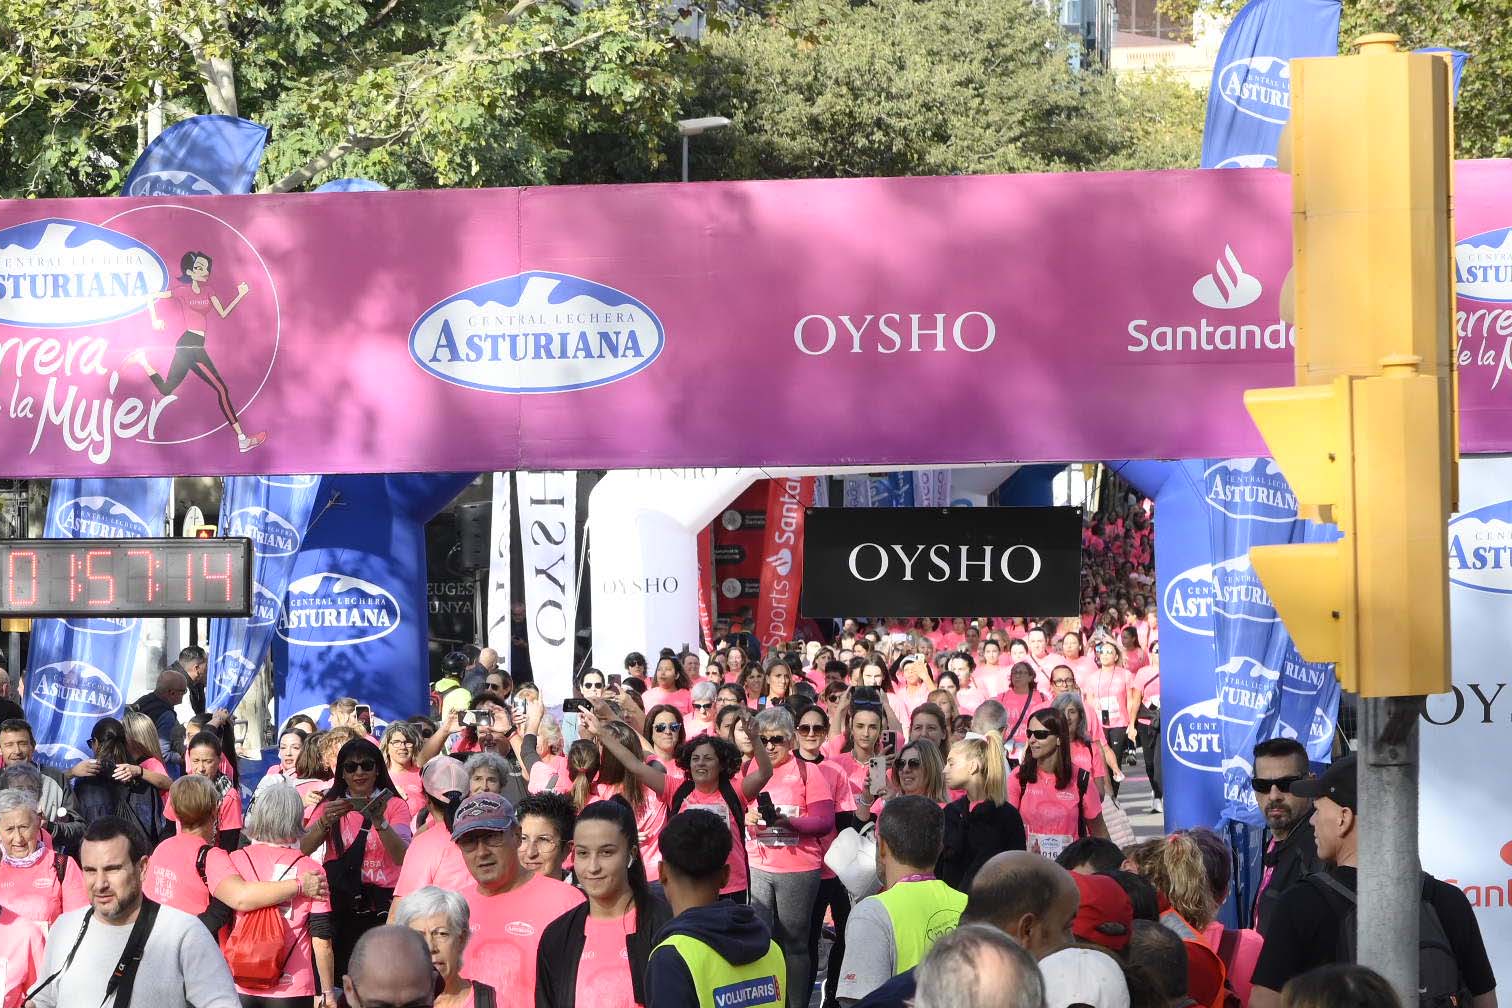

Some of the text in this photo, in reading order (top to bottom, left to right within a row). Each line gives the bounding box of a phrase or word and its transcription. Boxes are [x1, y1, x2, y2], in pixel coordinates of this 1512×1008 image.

[468, 310, 636, 328] CENTRAL LECHERA
[794, 310, 997, 357] OYSHO
[1127, 318, 1295, 353] Santand
[430, 318, 645, 363] ASTURIANA
[1477, 338, 1495, 366] la
[8, 382, 34, 420] la
[29, 371, 178, 465] Mujer
[848, 542, 1042, 585] OYSHO
[278, 602, 392, 630] ASTURIANA
[290, 598, 333, 607] CENTRAL
[762, 580, 789, 647] Sports
[1422, 683, 1512, 727] OY
[715, 983, 775, 1007] VOLUNTARIS
